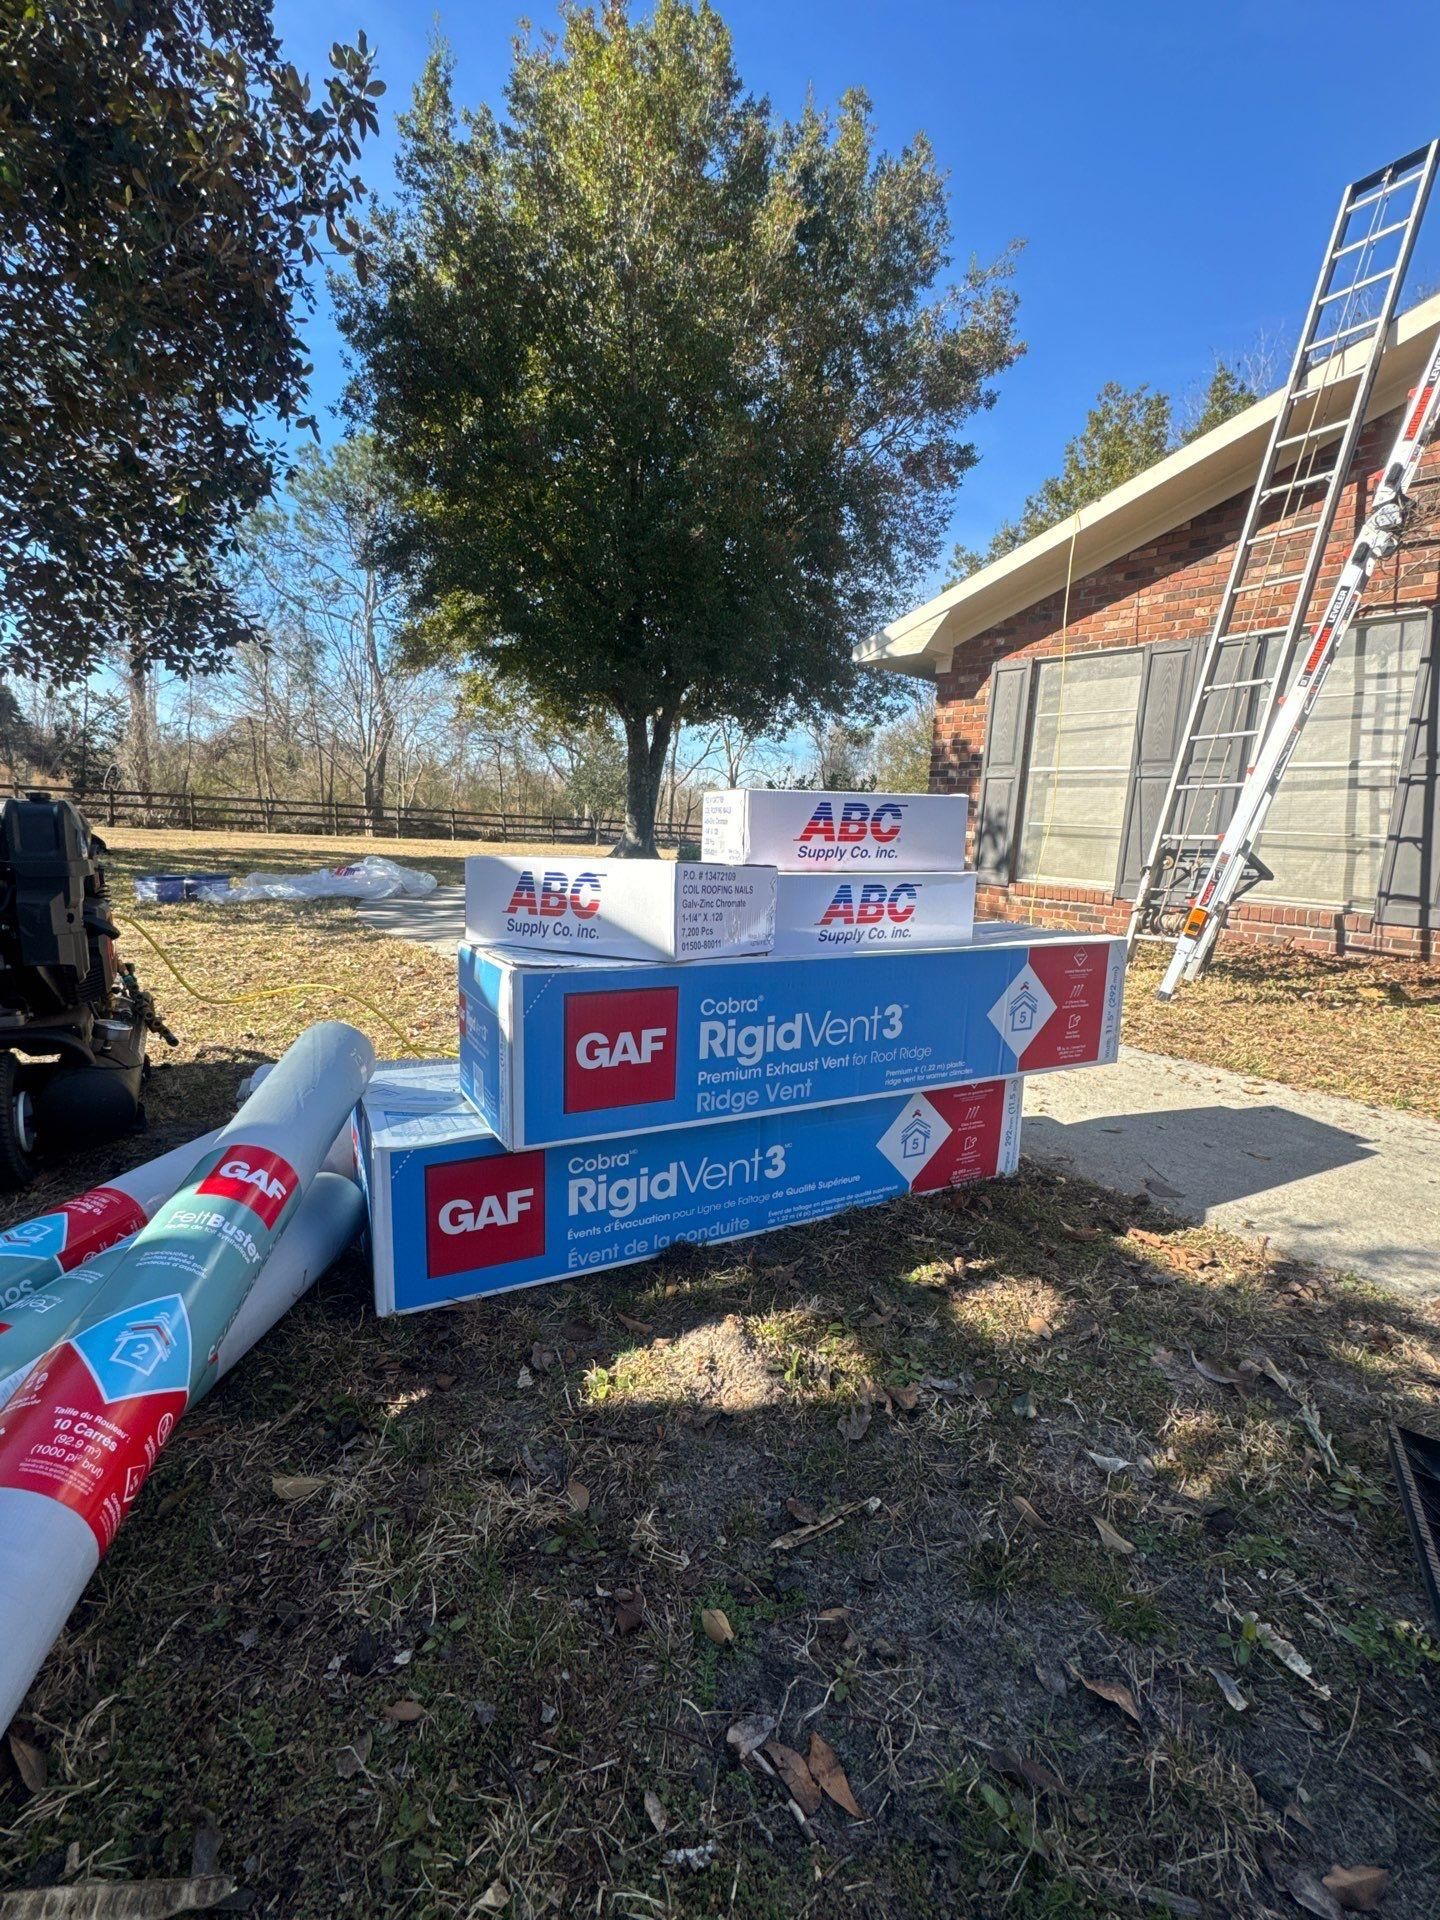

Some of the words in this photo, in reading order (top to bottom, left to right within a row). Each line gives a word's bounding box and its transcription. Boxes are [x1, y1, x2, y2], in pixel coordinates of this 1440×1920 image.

[1328, 589, 1348, 623] LEVELER
[793, 802, 908, 842] ABC
[797, 845, 846, 861] Supply
[850, 846, 872, 859] Co.
[875, 846, 898, 859] inc.
[502, 870, 607, 919] ABC
[682, 885, 699, 894] COIL
[701, 885, 733, 894] ROOFING
[734, 885, 754, 894] NAILS
[682, 899, 714, 909] Galv-Zinc
[715, 898, 746, 908] Chromate
[814, 883, 922, 926] ABC
[506, 919, 550, 938] Supply
[554, 921, 573, 937] Co.
[577, 924, 600, 939] inc.
[701, 927, 714, 936] Pcs
[818, 928, 864, 945] Supply
[867, 927, 889, 940] Co.
[892, 925, 912, 938] inc.
[700, 997, 759, 1017] Cobra
[1018, 1012, 1026, 1024] 5
[575, 1028, 667, 1070] GAF
[698, 1067, 762, 1085] Premium
[766, 1058, 819, 1077] Exhaust
[820, 1056, 849, 1070] Vent
[852, 1052, 868, 1066] for
[870, 1049, 897, 1063] Roof
[899, 1046, 932, 1061] Ridge
[886, 1068, 913, 1077] Premium
[946, 1060, 966, 1069] plastic
[696, 1089, 760, 1114] Ridge
[765, 1078, 812, 1103] Vent
[912, 1138, 919, 1150] 5
[568, 1150, 630, 1175] Cobra
[219, 1160, 287, 1200] GAF
[438, 1188, 535, 1236] GAF
[567, 1227, 601, 1240] Évents
[673, 1208, 695, 1220] pour
[697, 1203, 721, 1215] Ligne
[723, 1200, 736, 1208] de
[772, 1190, 784, 1199] de
[786, 1182, 816, 1195] Qualité
[818, 1174, 860, 1189] Supérieure
[568, 1247, 620, 1269] Évent
[624, 1239, 648, 1256] de
[654, 1234, 670, 1250] la
[675, 1217, 750, 1243] conduite
[130, 1343, 150, 1360] 2
[53, 1406, 79, 1418] Taille
[79, 1409, 94, 1420] du
[93, 1414, 129, 1440] Rouleau
[53, 1418, 72, 1430] 10
[73, 1421, 118, 1452] Carrés
[53, 1433, 84, 1448] (92.9
[30, 1443, 65, 1458] (1000
[81, 1458, 104, 1480] brut)
